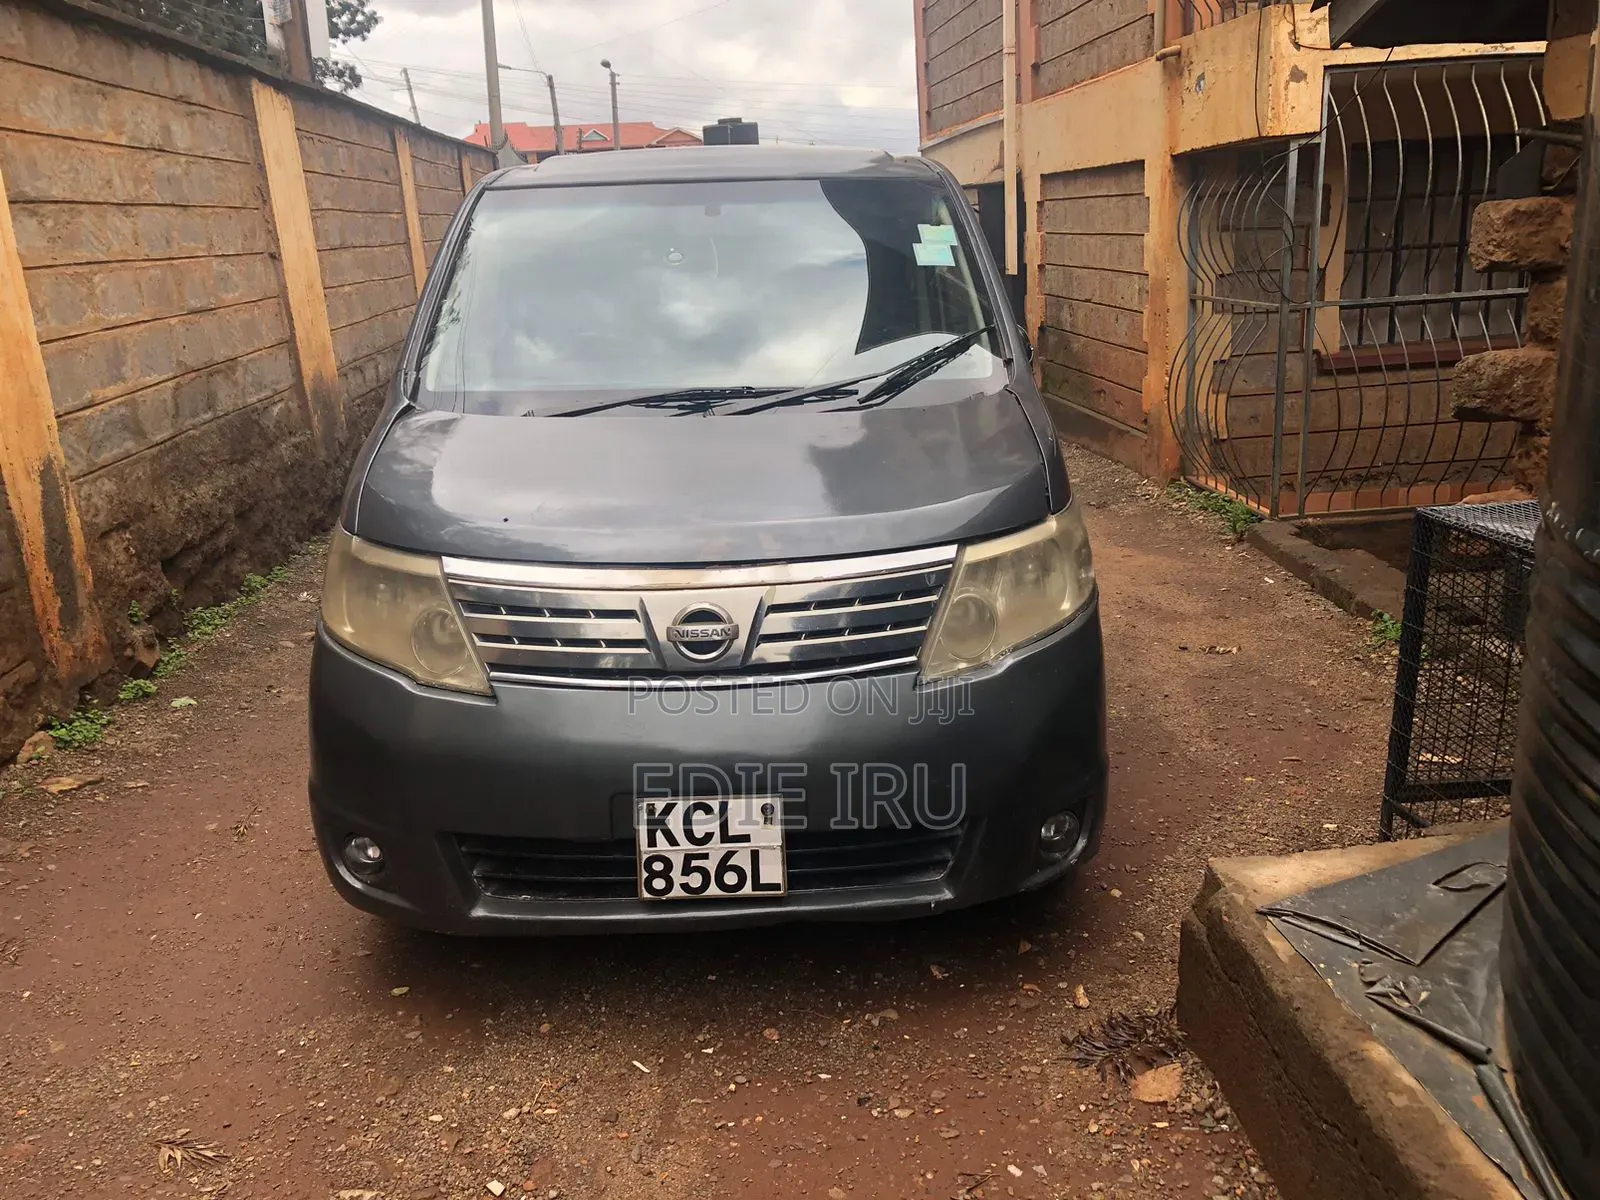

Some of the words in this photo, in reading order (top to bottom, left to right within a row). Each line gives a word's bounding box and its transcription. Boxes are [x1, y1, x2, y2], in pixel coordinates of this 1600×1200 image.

[671, 627, 732, 640] NISSAN
[646, 800, 751, 848] KCL
[643, 850, 782, 897] 856L
